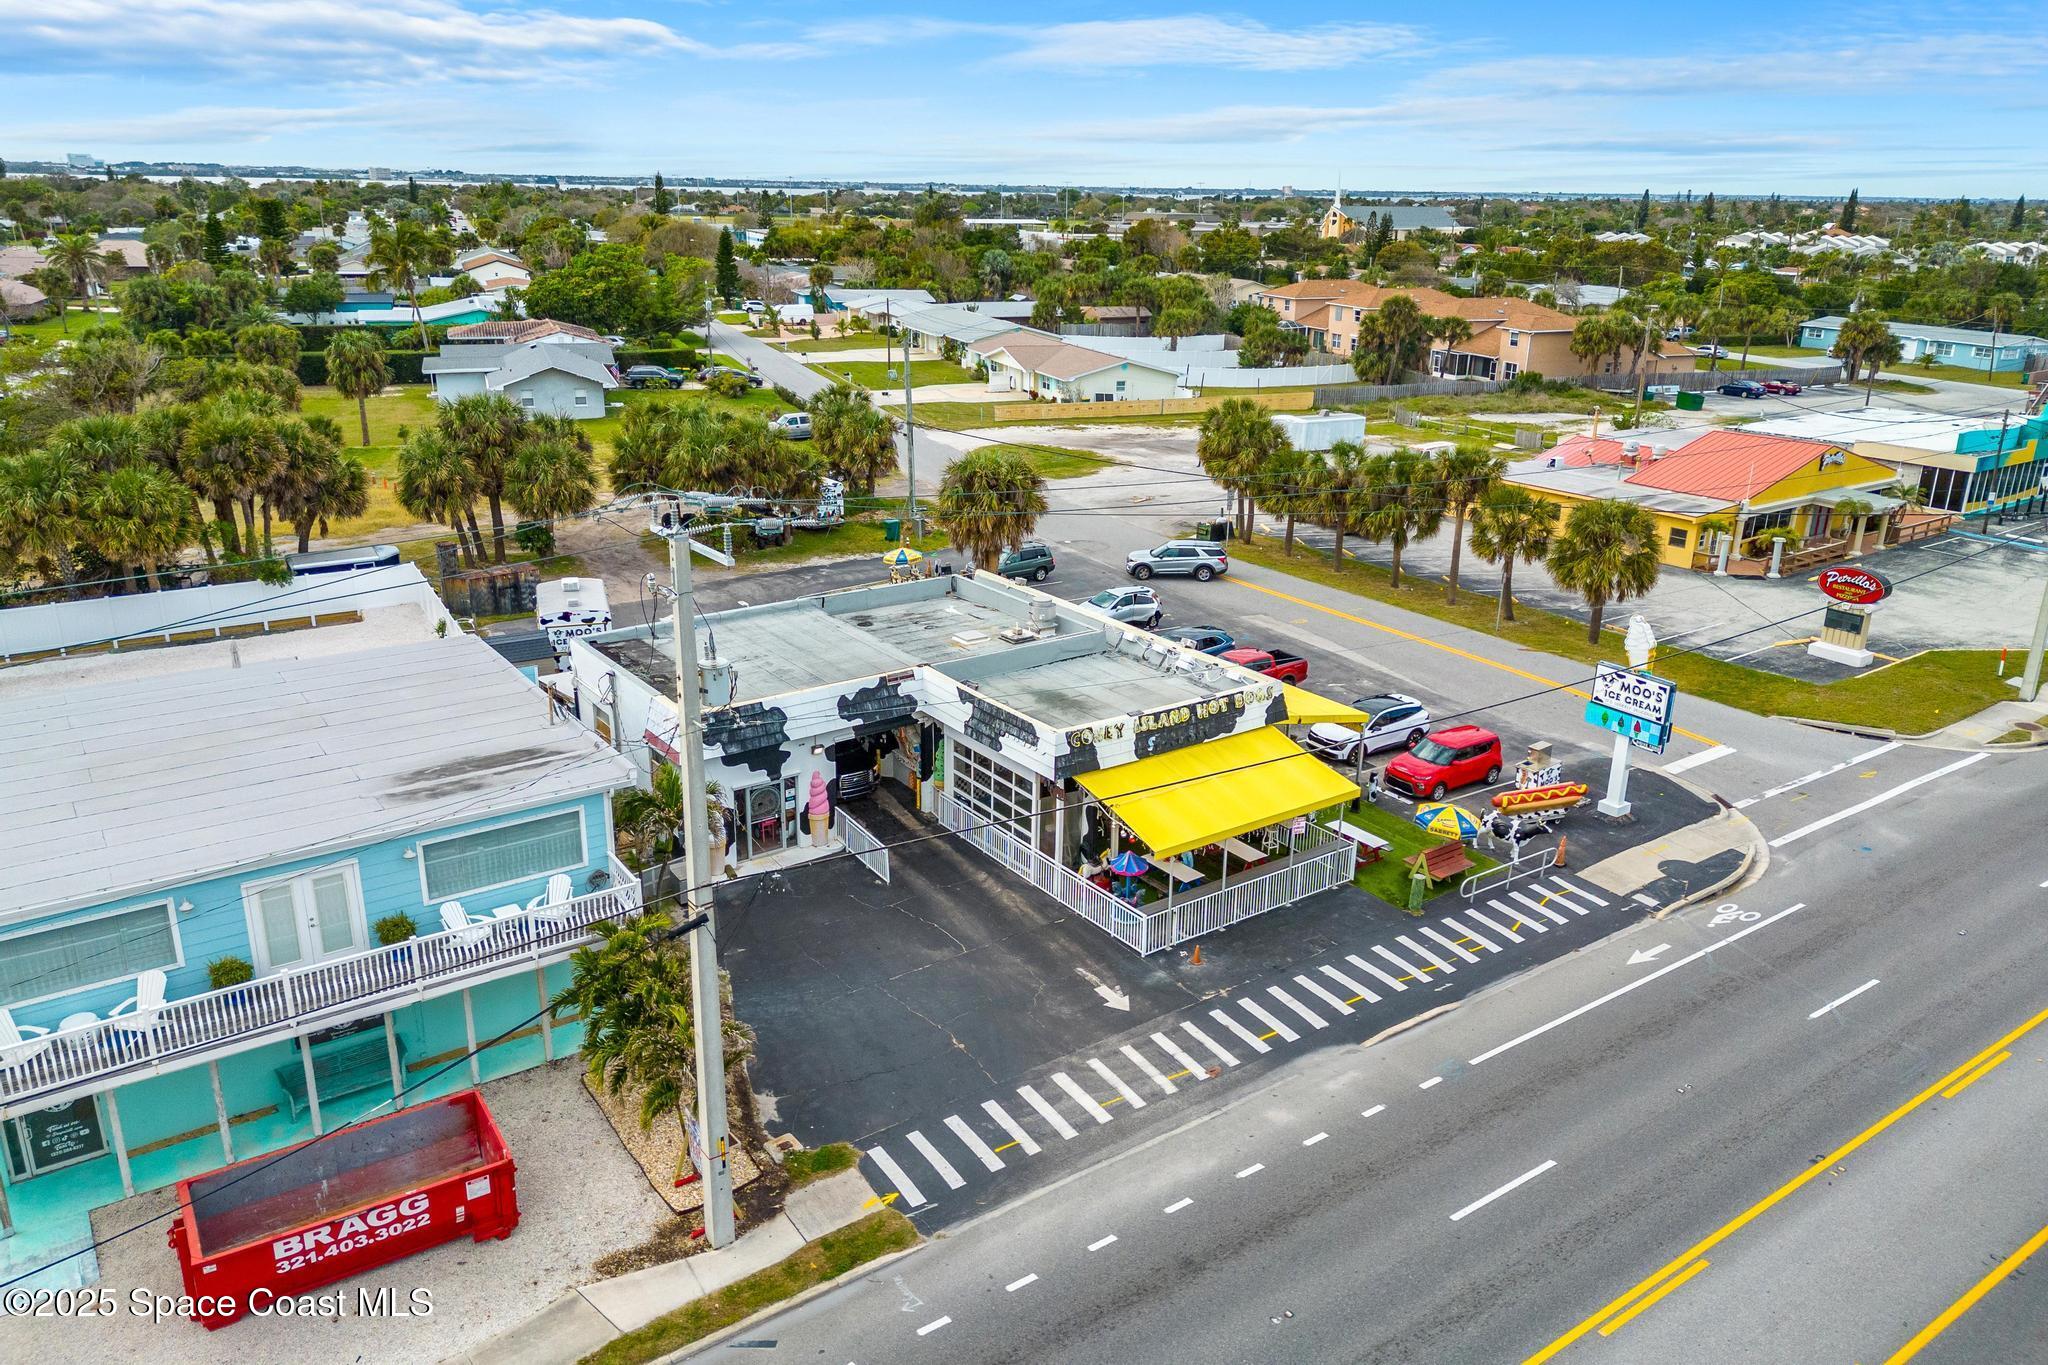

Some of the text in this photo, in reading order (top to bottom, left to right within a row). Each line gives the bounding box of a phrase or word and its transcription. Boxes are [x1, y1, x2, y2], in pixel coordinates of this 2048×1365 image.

[1826, 571, 1877, 591] Petrillo's
[552, 638, 568, 646] ICE
[565, 628, 602, 638] MOO'S
[1604, 689, 1622, 701] ICE
[1624, 696, 1662, 715] CREAM
[1620, 681, 1663, 704] MOO'S
[1133, 706, 1191, 734] ISLAND
[1196, 696, 1229, 719] HOT
[1234, 685, 1274, 710] DOGS
[272, 1193, 430, 1260] BRAGG
[275, 1213, 431, 1275] 321.403.3022
